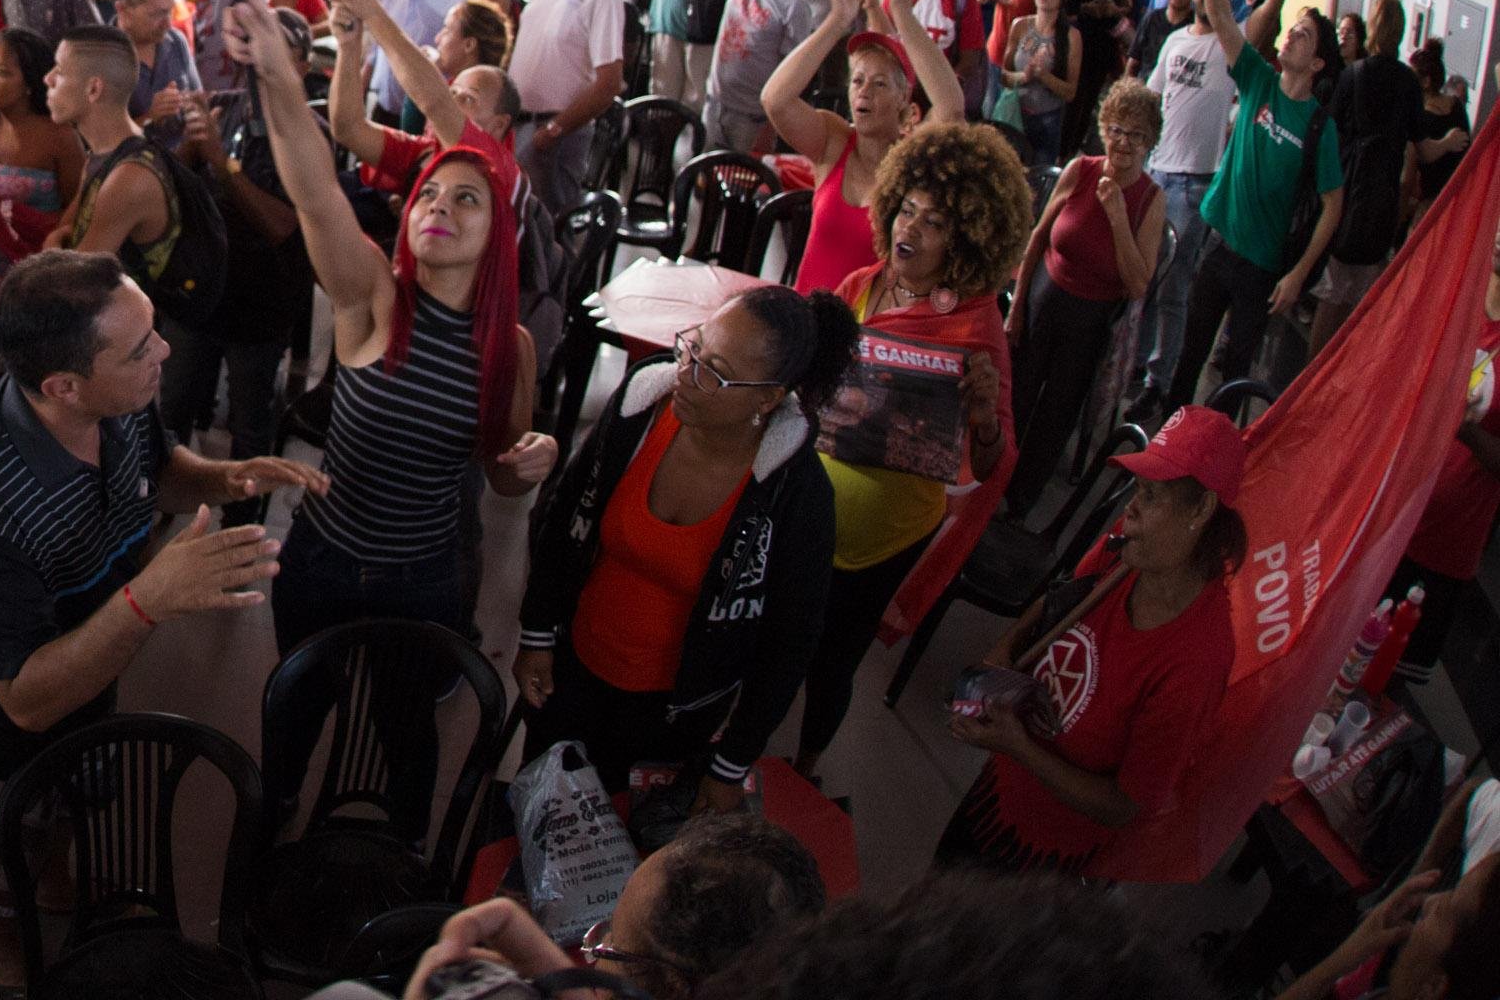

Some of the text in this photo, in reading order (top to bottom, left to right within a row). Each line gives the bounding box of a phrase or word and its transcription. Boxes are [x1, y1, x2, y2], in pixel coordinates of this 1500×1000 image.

[873, 344, 960, 375] GANHAR
[1253, 541, 1291, 654] POVO
[1349, 743, 1371, 770] ATÉ
[558, 842, 592, 859] Moda
[586, 888, 619, 906] Loja
